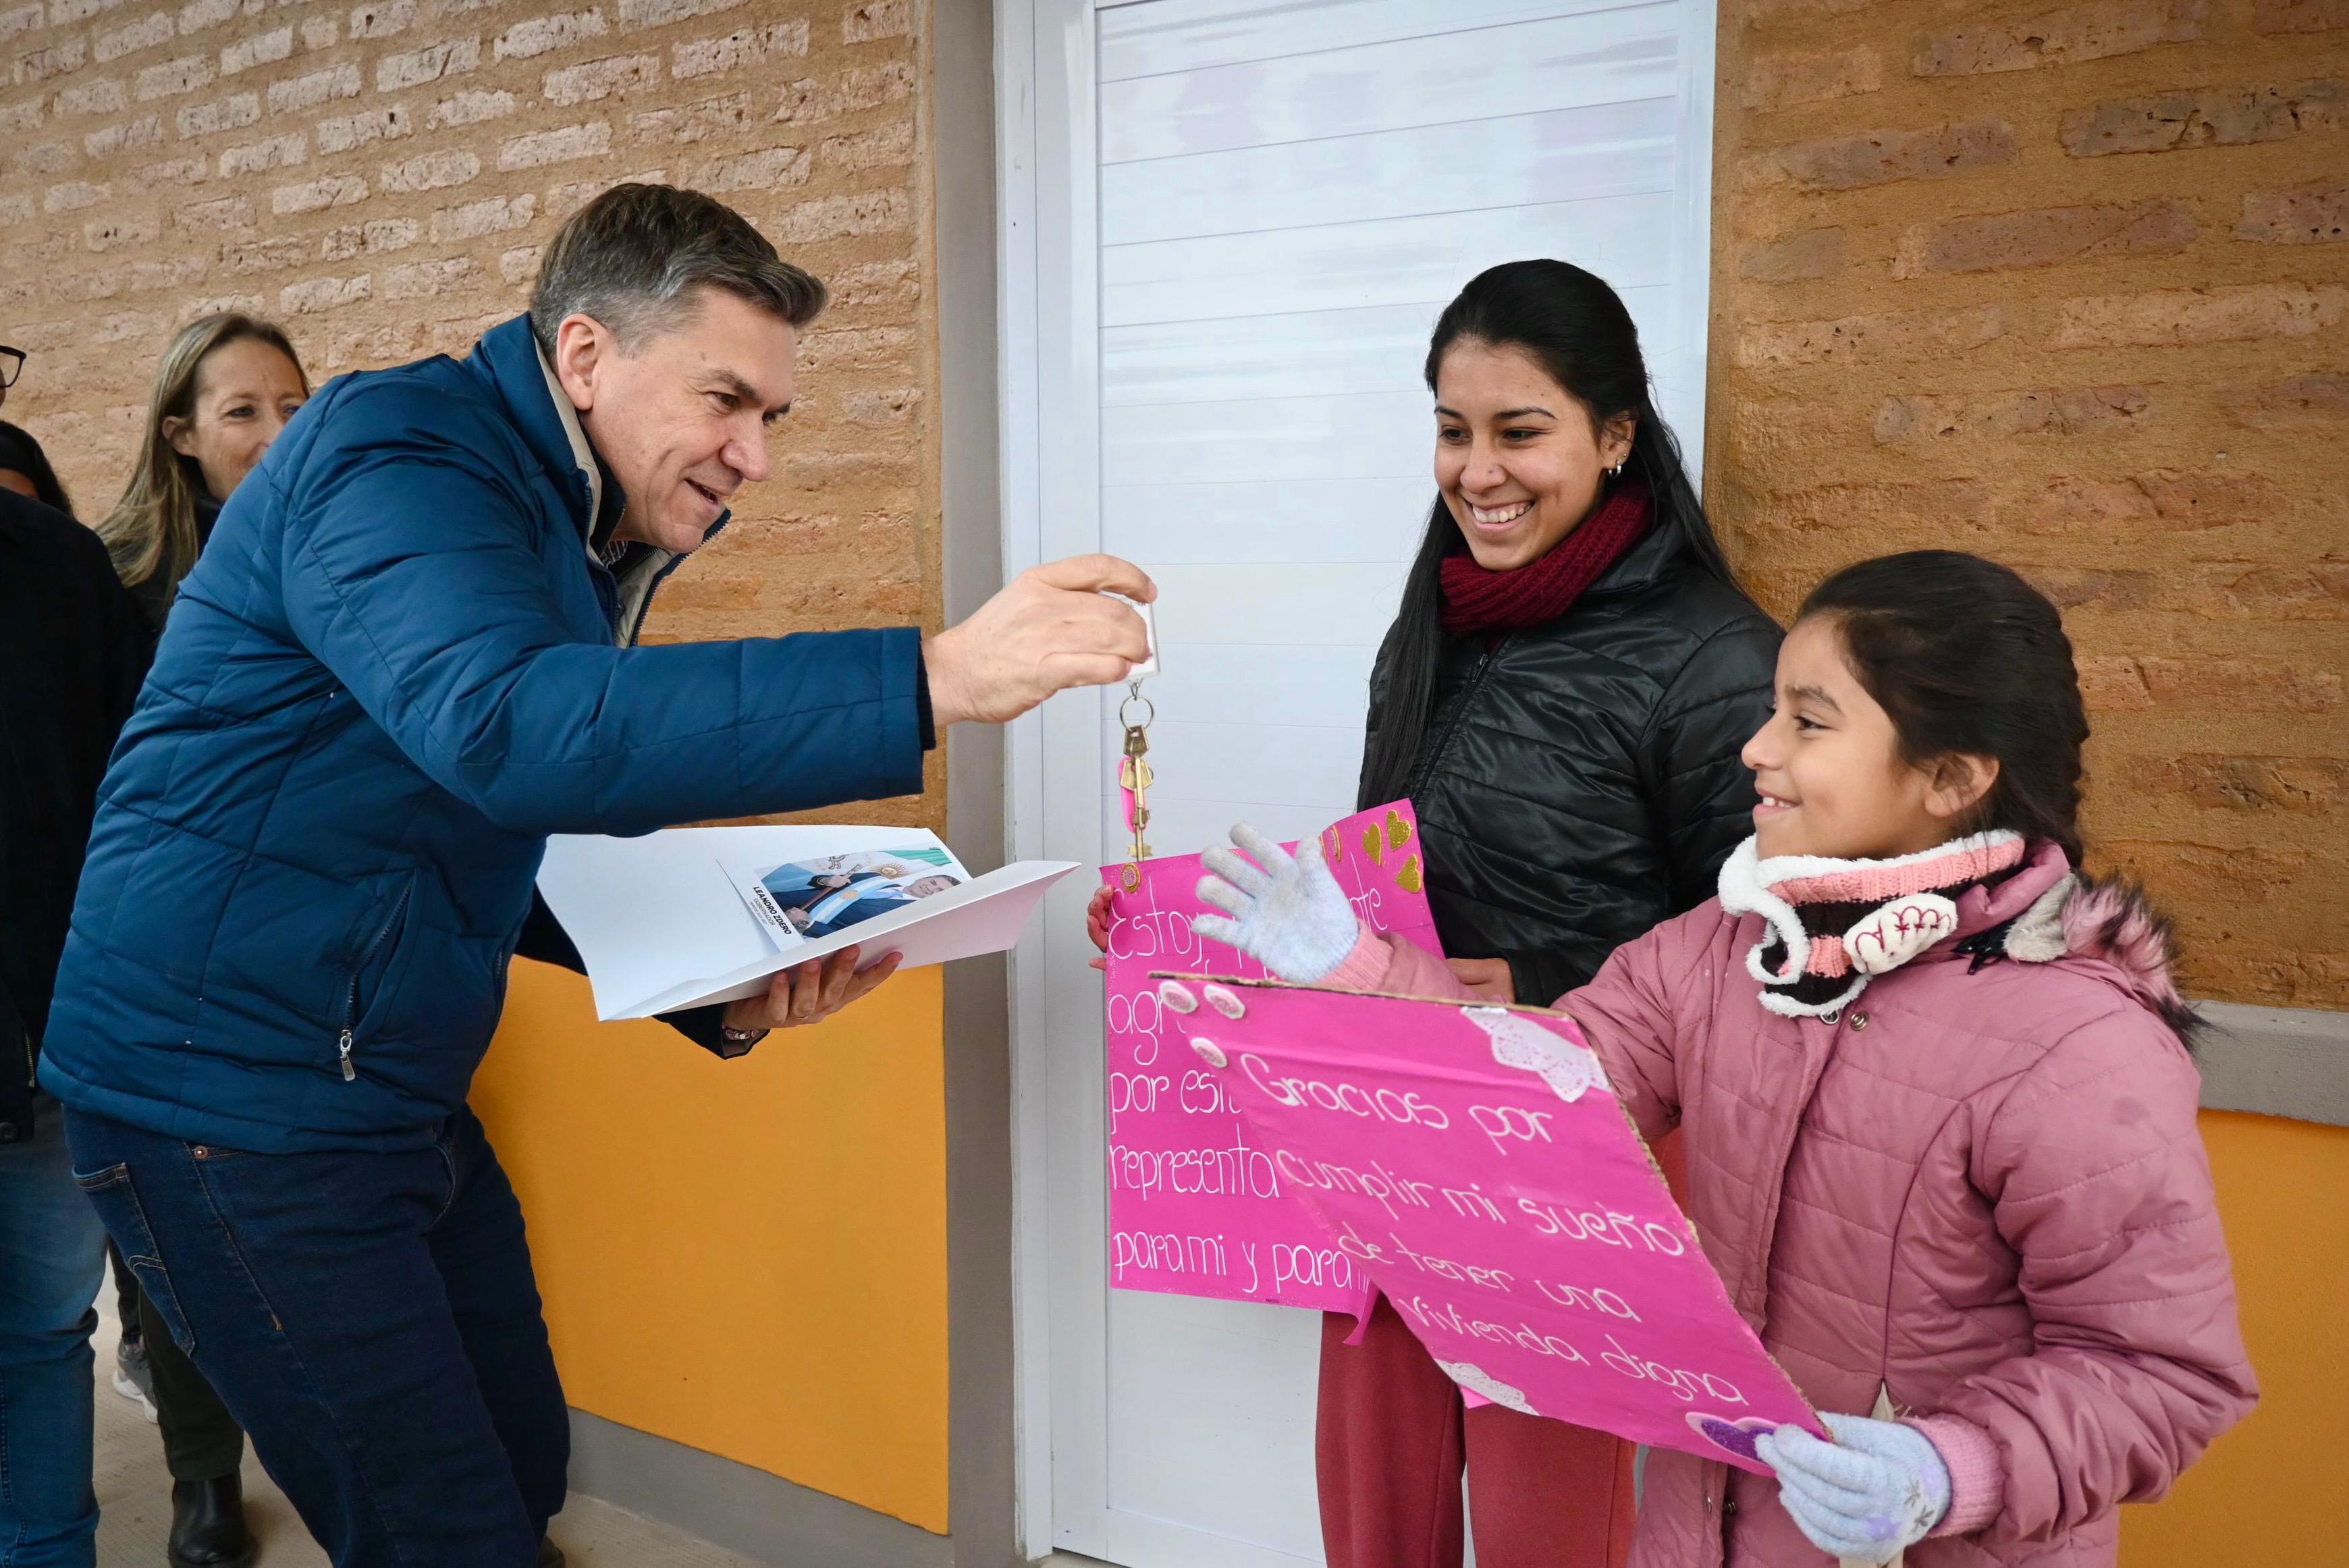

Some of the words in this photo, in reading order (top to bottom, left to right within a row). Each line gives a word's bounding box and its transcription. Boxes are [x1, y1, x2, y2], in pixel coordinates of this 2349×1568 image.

[753, 886, 777, 915] LEANDRO
[774, 915, 792, 935] ZDERO
[1110, 1072, 1170, 1135] por
[1240, 1053, 1449, 1129] Gracias
[1467, 1105, 1552, 1156] por
[1109, 1123, 1280, 1201] representa
[1440, 1182, 1507, 1225] mi
[1517, 1197, 1685, 1256] sueño
[1241, 1240, 1259, 1294] y
[1272, 1244, 1353, 1294] para
[1338, 1220, 1395, 1265] de
[1388, 1232, 1515, 1293] tener
[1534, 1279, 1642, 1323] una
[1600, 1333, 1750, 1407] digna
